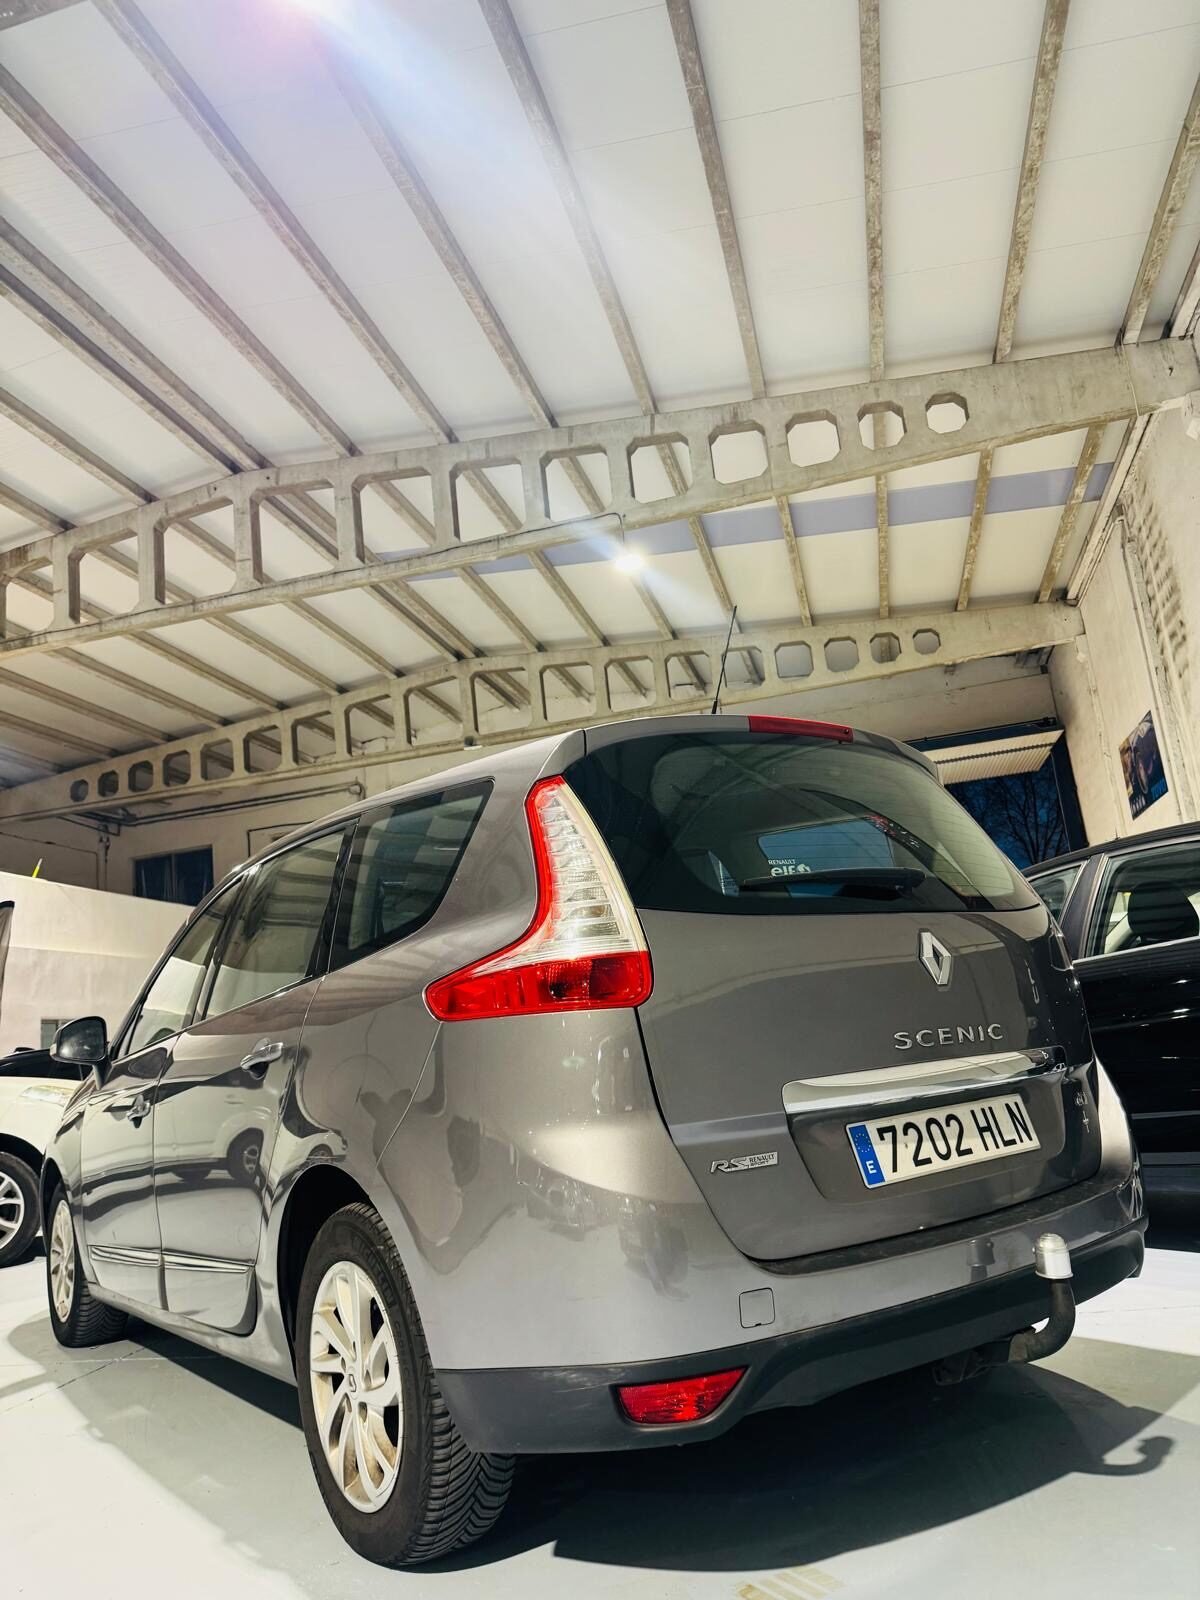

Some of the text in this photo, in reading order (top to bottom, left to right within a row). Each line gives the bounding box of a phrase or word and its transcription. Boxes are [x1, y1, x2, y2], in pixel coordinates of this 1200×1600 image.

[893, 1023, 1005, 1050] SCENIC
[877, 1100, 1034, 1174] 7202 HLN
[749, 1154, 775, 1163] RENAULT
[866, 1161, 877, 1174] E
